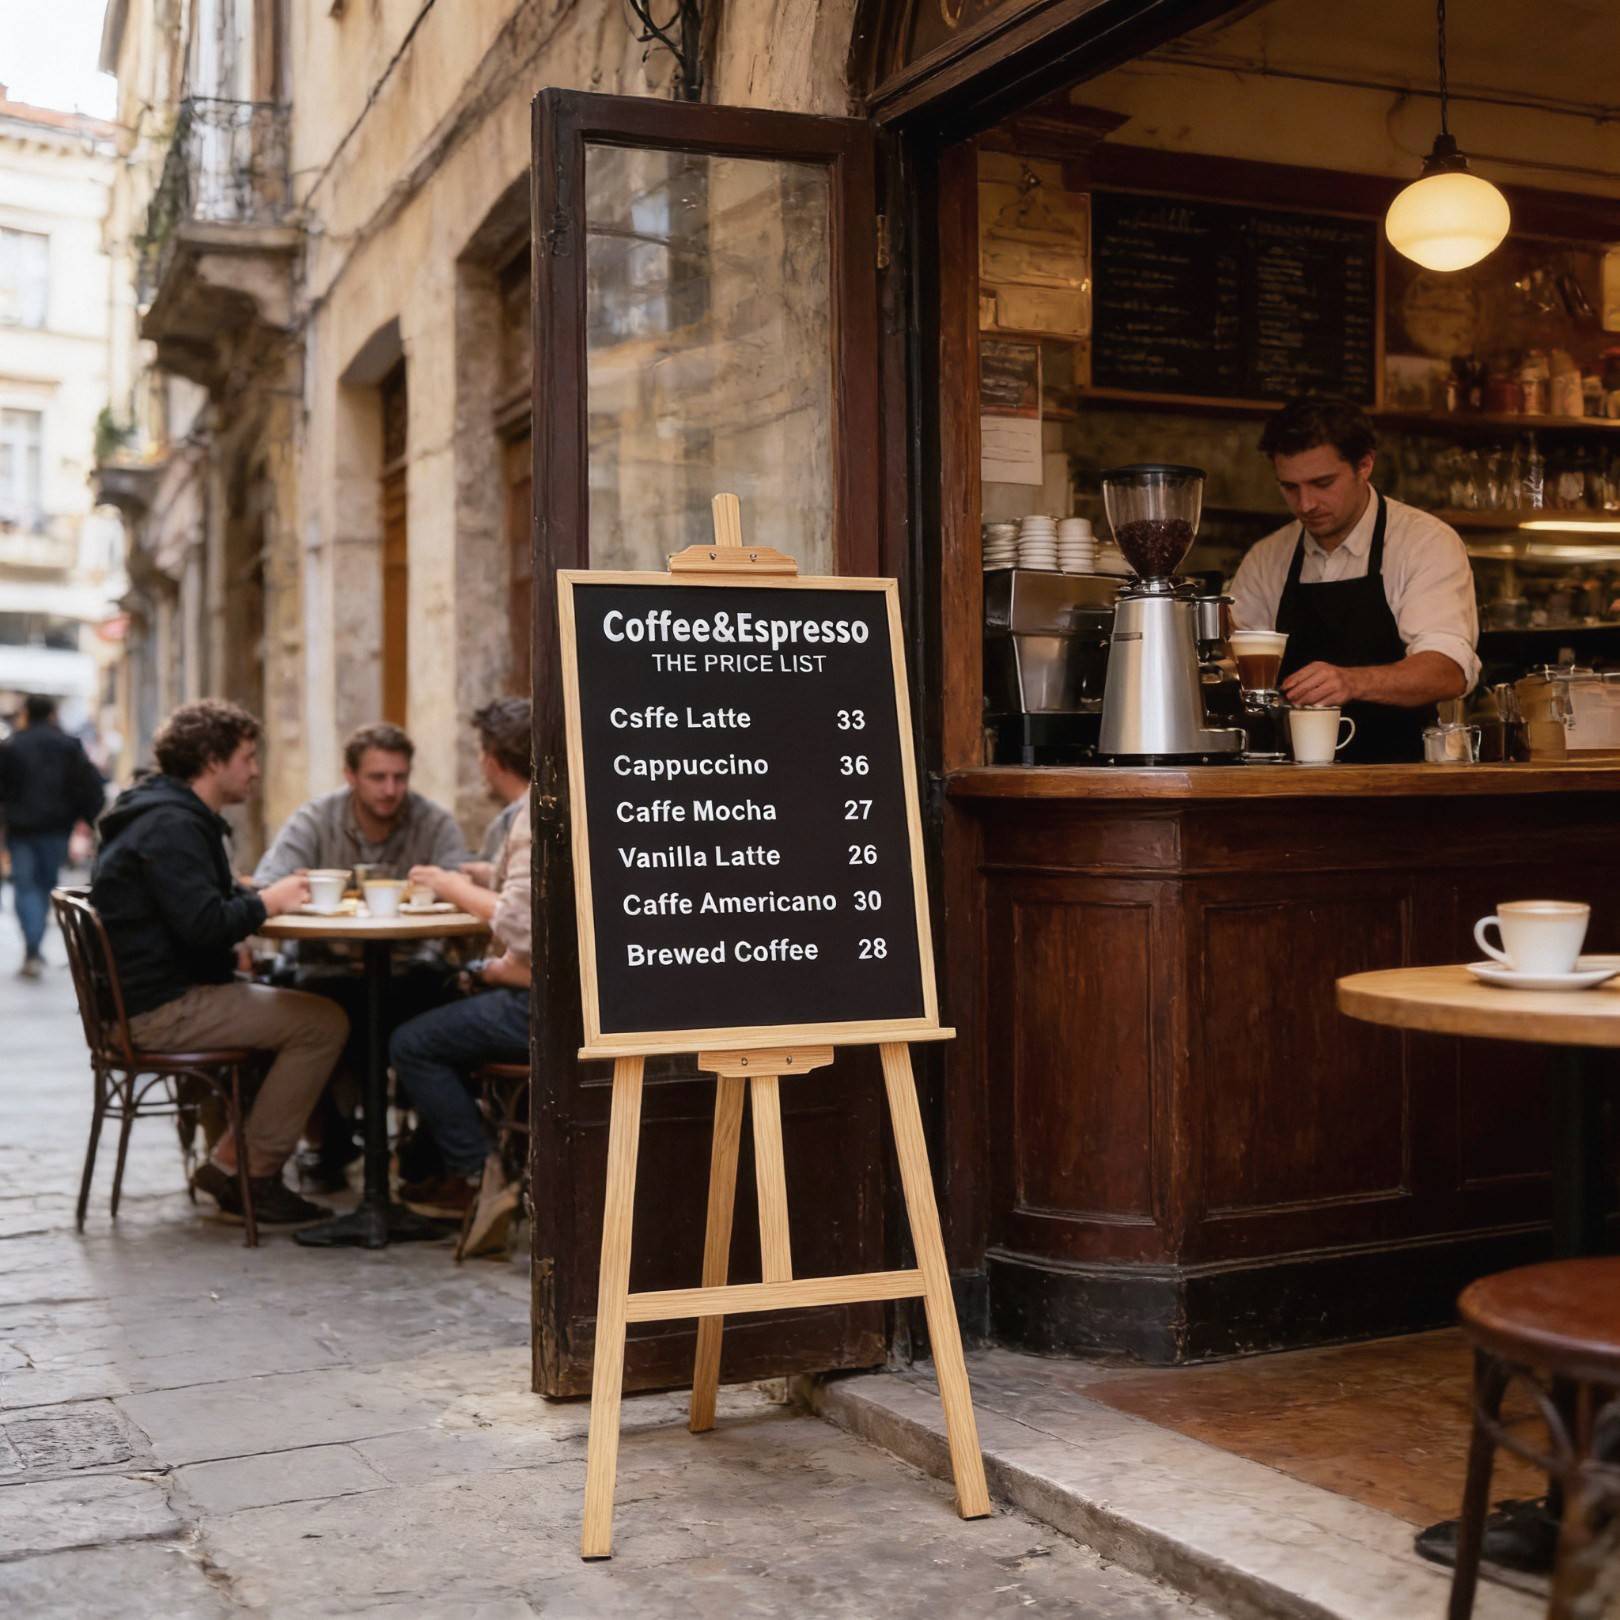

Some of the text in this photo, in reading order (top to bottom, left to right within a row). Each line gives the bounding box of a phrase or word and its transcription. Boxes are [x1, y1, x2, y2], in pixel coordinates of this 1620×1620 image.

[603, 609, 869, 651] Coffee&Espresso
[652, 653, 827, 673] THE PRICE LIST
[609, 705, 866, 730] Csffe Latte 33
[613, 753, 870, 781] Cappuccino 36
[616, 799, 873, 824] Caffe Mocha 27
[617, 844, 878, 869] Vanilla Latte 26
[622, 889, 883, 917] Caffe Americano 30
[626, 937, 887, 967] Brewed Coffee 28
